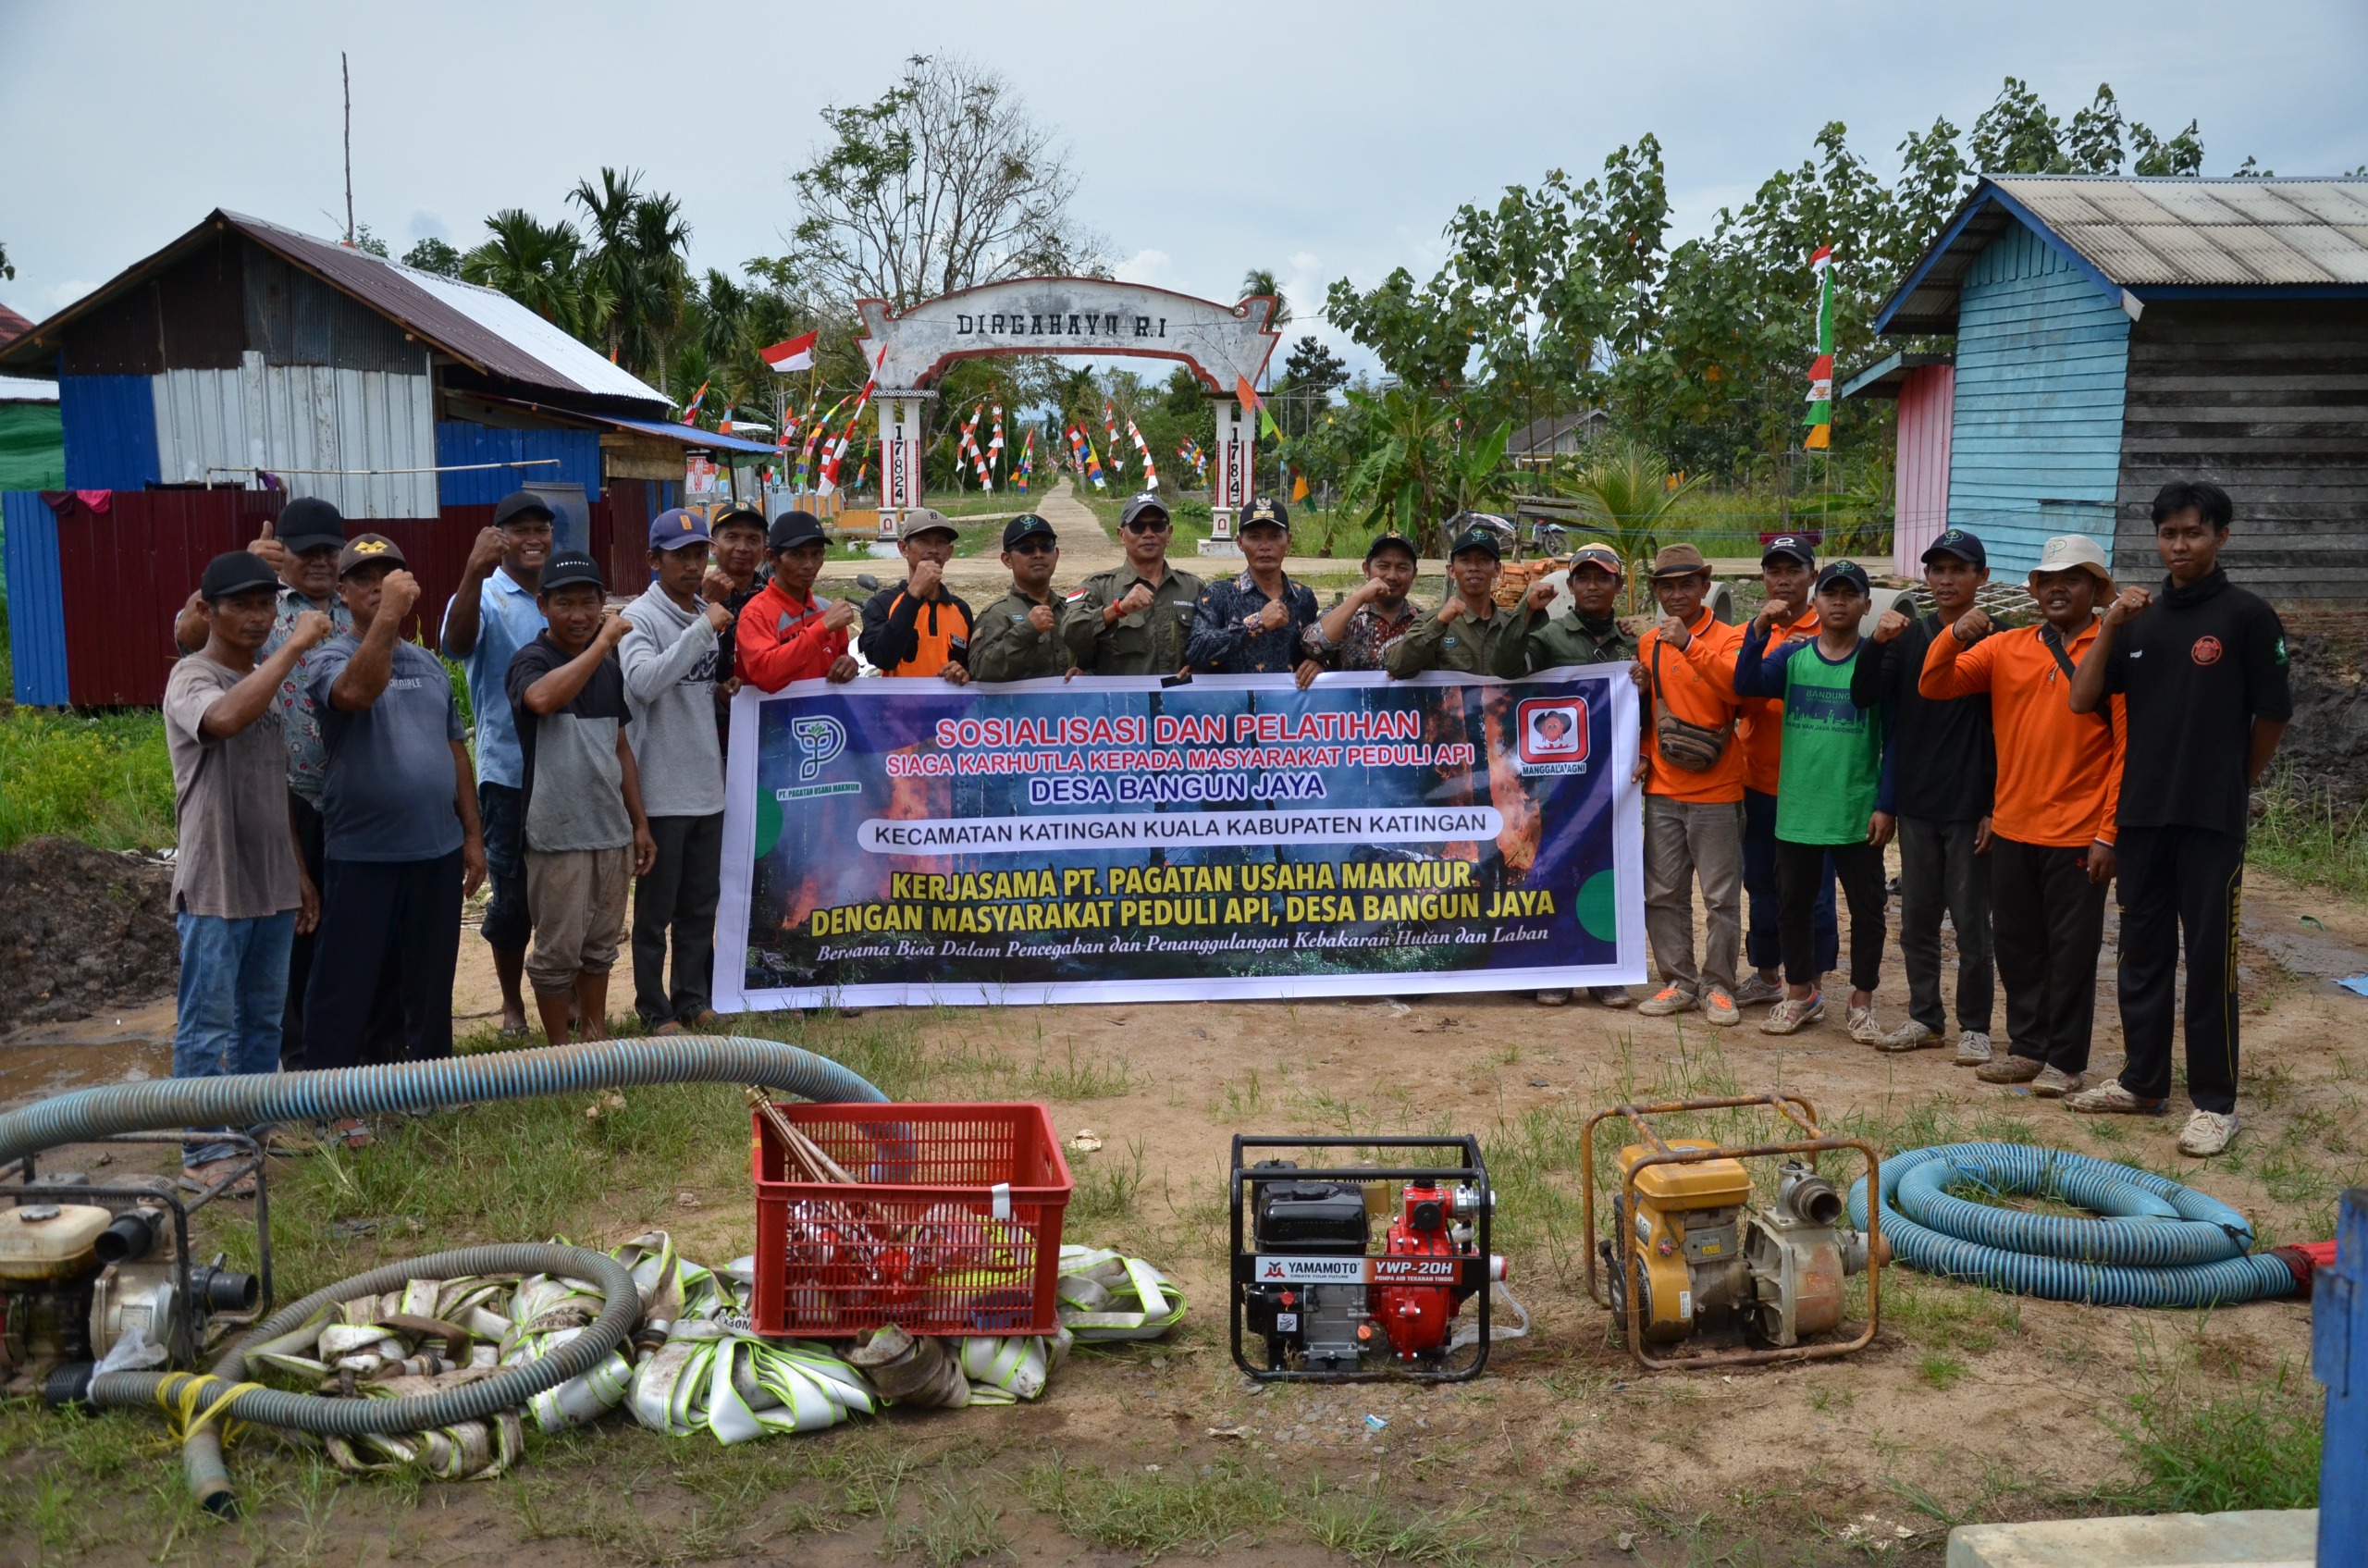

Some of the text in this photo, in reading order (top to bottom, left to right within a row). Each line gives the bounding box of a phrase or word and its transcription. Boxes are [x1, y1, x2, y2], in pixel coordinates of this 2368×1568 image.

[956, 314, 1118, 336] DIRGAHAYU
[1806, 690, 1850, 700] BANDUNG
[937, 710, 1419, 747] SOSIALISASI DAN PELATIHAN
[887, 744, 1474, 775] SIAGA KARHUTLA KEPADA MASYARAKAT PEDULI API
[1523, 763, 1585, 775] MANGGALA AGNI
[788, 787, 813, 798] PAGATAN
[814, 785, 832, 796] USAHA
[832, 784, 859, 793] MAKMUR
[1031, 774, 1326, 803] DESA BANGUN JAYA
[876, 814, 1486, 845] KECAMATAN KATINGAN KUALA KABUPATEN KATINGAN
[892, 861, 1471, 901] KERJASAMA PT. PAGATAN USAHA MAKMUR
[811, 890, 1555, 937] DENGAN MASYARAKAT PEDULI API, DESA BANGUN JAYA
[816, 926, 1548, 962] Bersama Bisa Dalam Pencegahan dan Penanggulangan Kebakaran Hutan dan Lahan
[1289, 1262, 1453, 1274] YAMAMOTO YWP-20H
